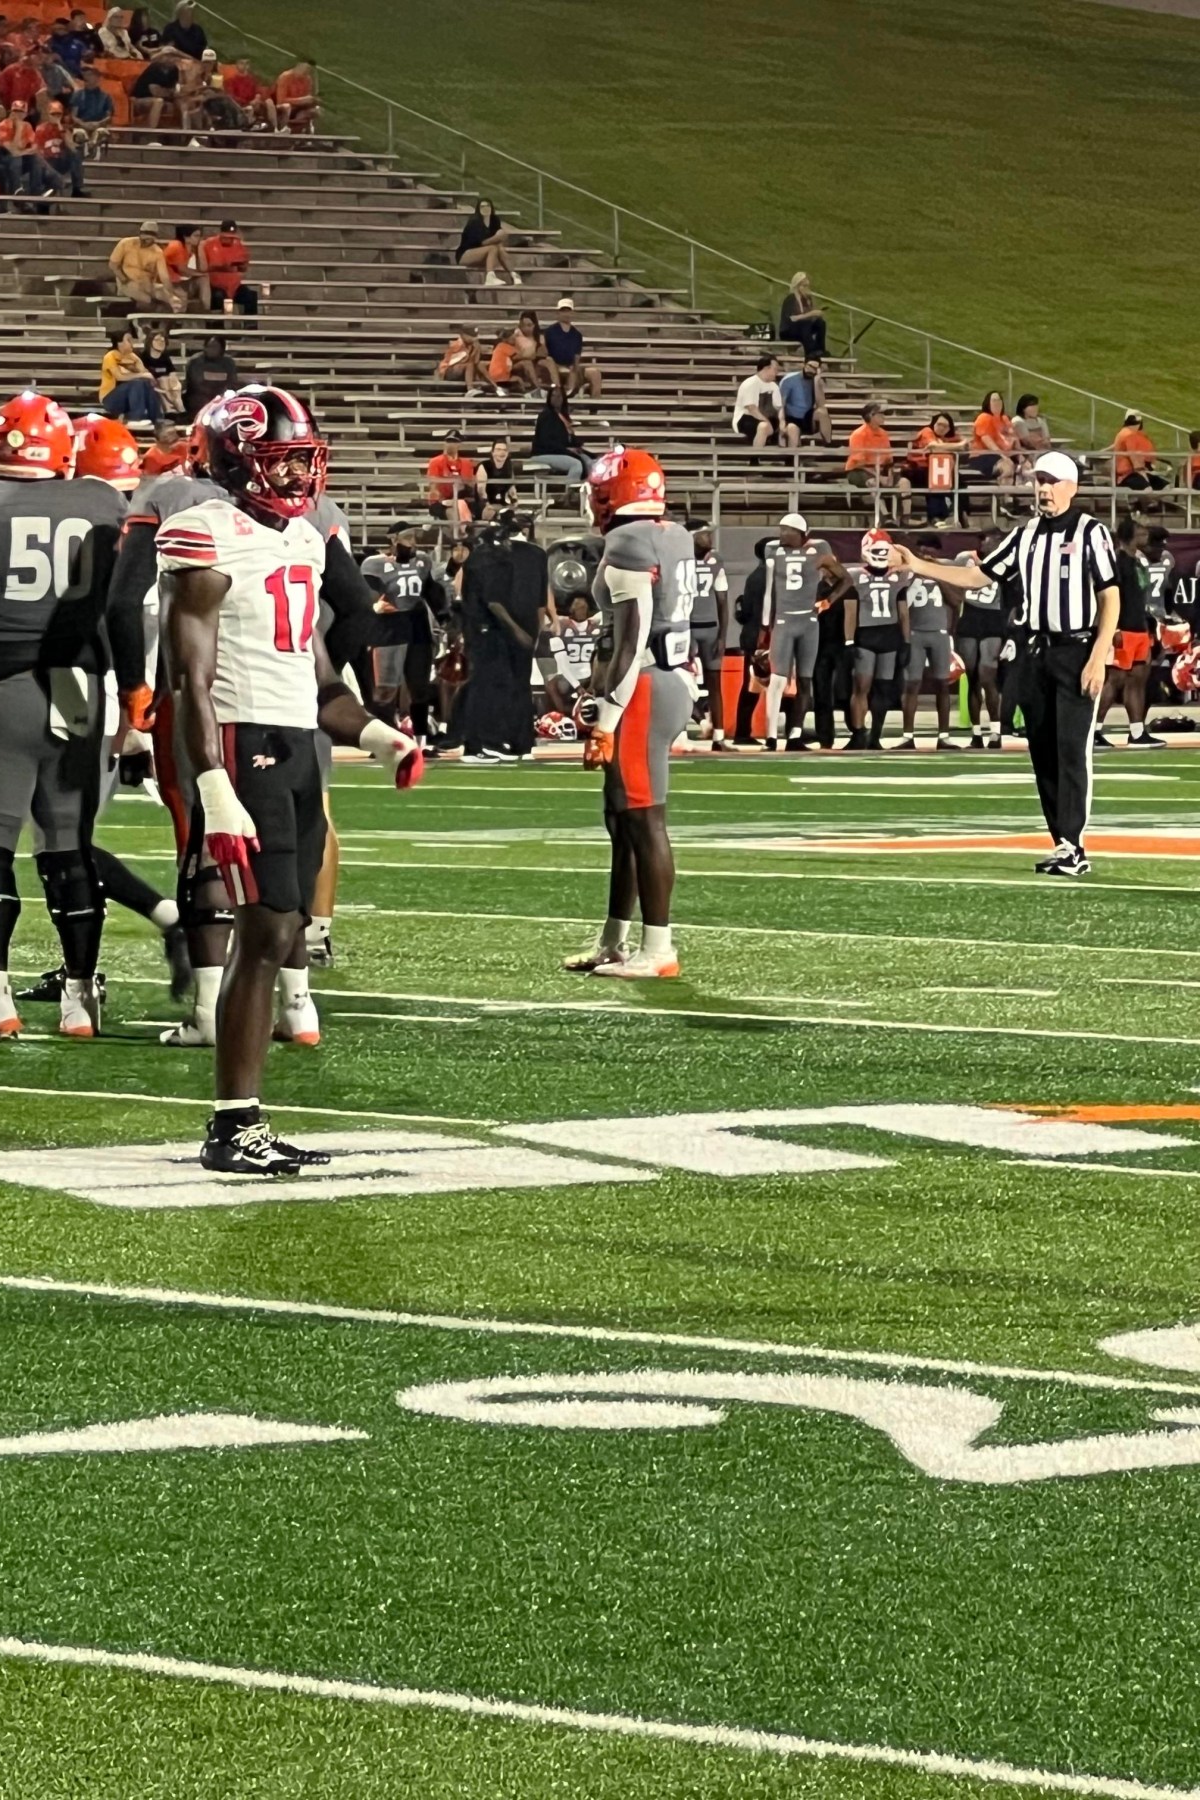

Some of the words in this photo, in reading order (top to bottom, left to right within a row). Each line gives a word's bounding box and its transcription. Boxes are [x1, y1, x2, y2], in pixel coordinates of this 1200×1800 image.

[932, 457, 950, 486] H
[4, 516, 93, 601] 50
[397, 575, 423, 598] 10
[1150, 573, 1164, 597] 7
[1173, 577, 1199, 605] AJ
[264, 565, 316, 654] 17
[870, 589, 892, 618] 11
